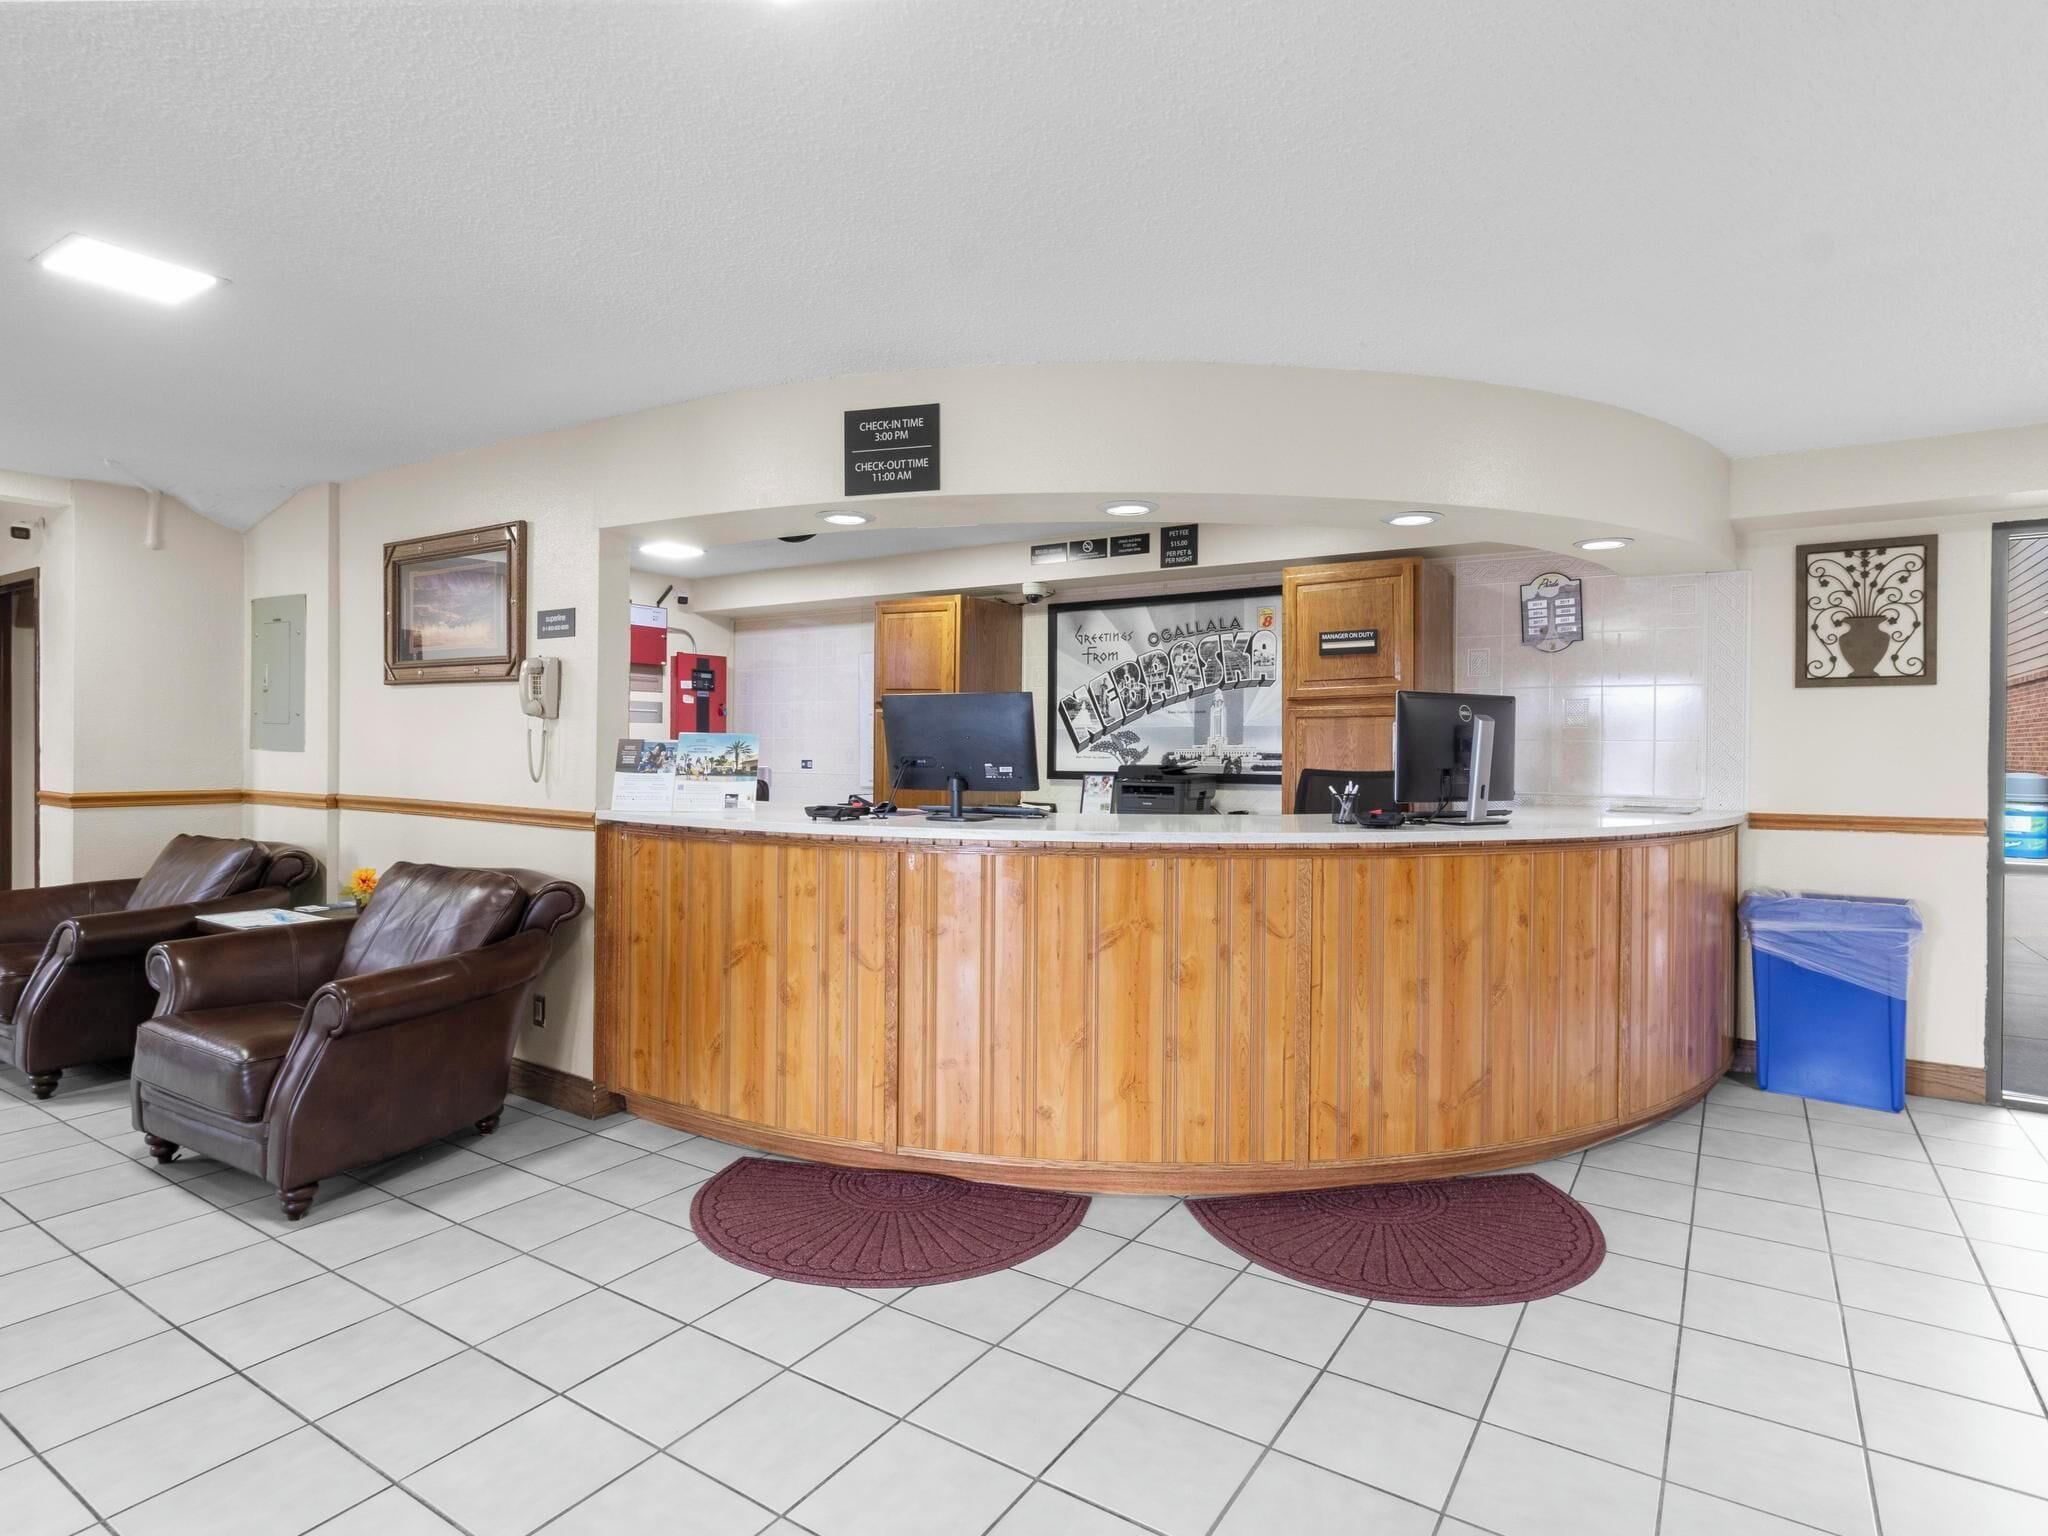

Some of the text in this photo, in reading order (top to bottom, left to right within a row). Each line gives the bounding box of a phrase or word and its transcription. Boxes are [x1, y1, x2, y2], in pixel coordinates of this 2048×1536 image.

[860, 418, 923, 431] CHECK-IN TIME
[875, 430, 908, 441] 3:00 PM
[855, 458, 928, 471] CHECK-OUT TIME
[872, 470, 912, 482] 11:00 AM
[1179, 528, 1190, 536] FEE
[1175, 555, 1193, 563] NIGHT
[1262, 615, 1273, 628] 8
[1147, 616, 1244, 647] OGALLALA
[1058, 630, 1278, 753] NEBRASKA
